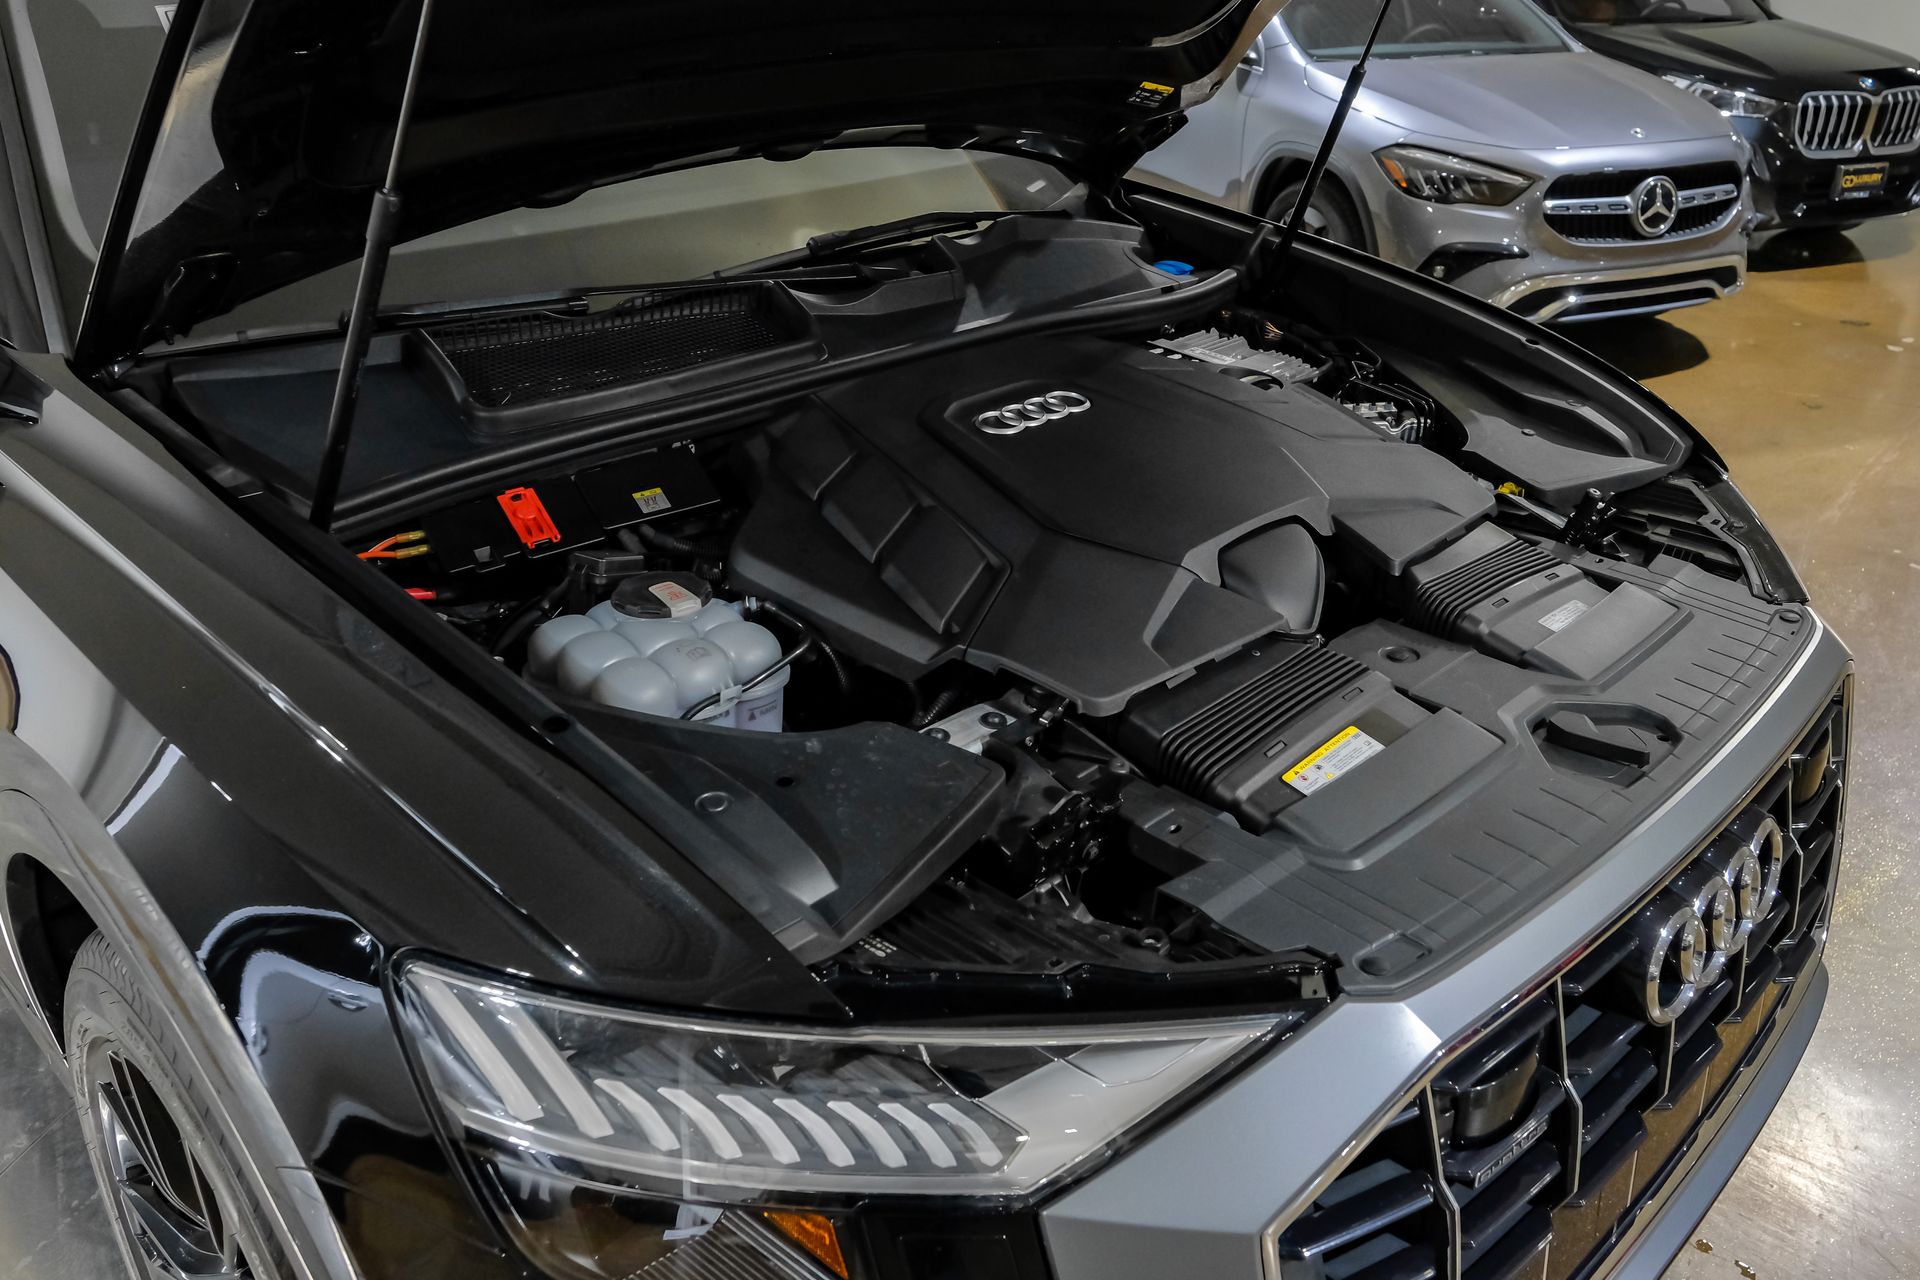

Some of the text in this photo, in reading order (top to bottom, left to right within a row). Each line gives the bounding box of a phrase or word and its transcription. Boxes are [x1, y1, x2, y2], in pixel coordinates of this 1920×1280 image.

[1299, 732, 1351, 771] WARNING ATTENTION
[1479, 1121, 1548, 1185] quattro
